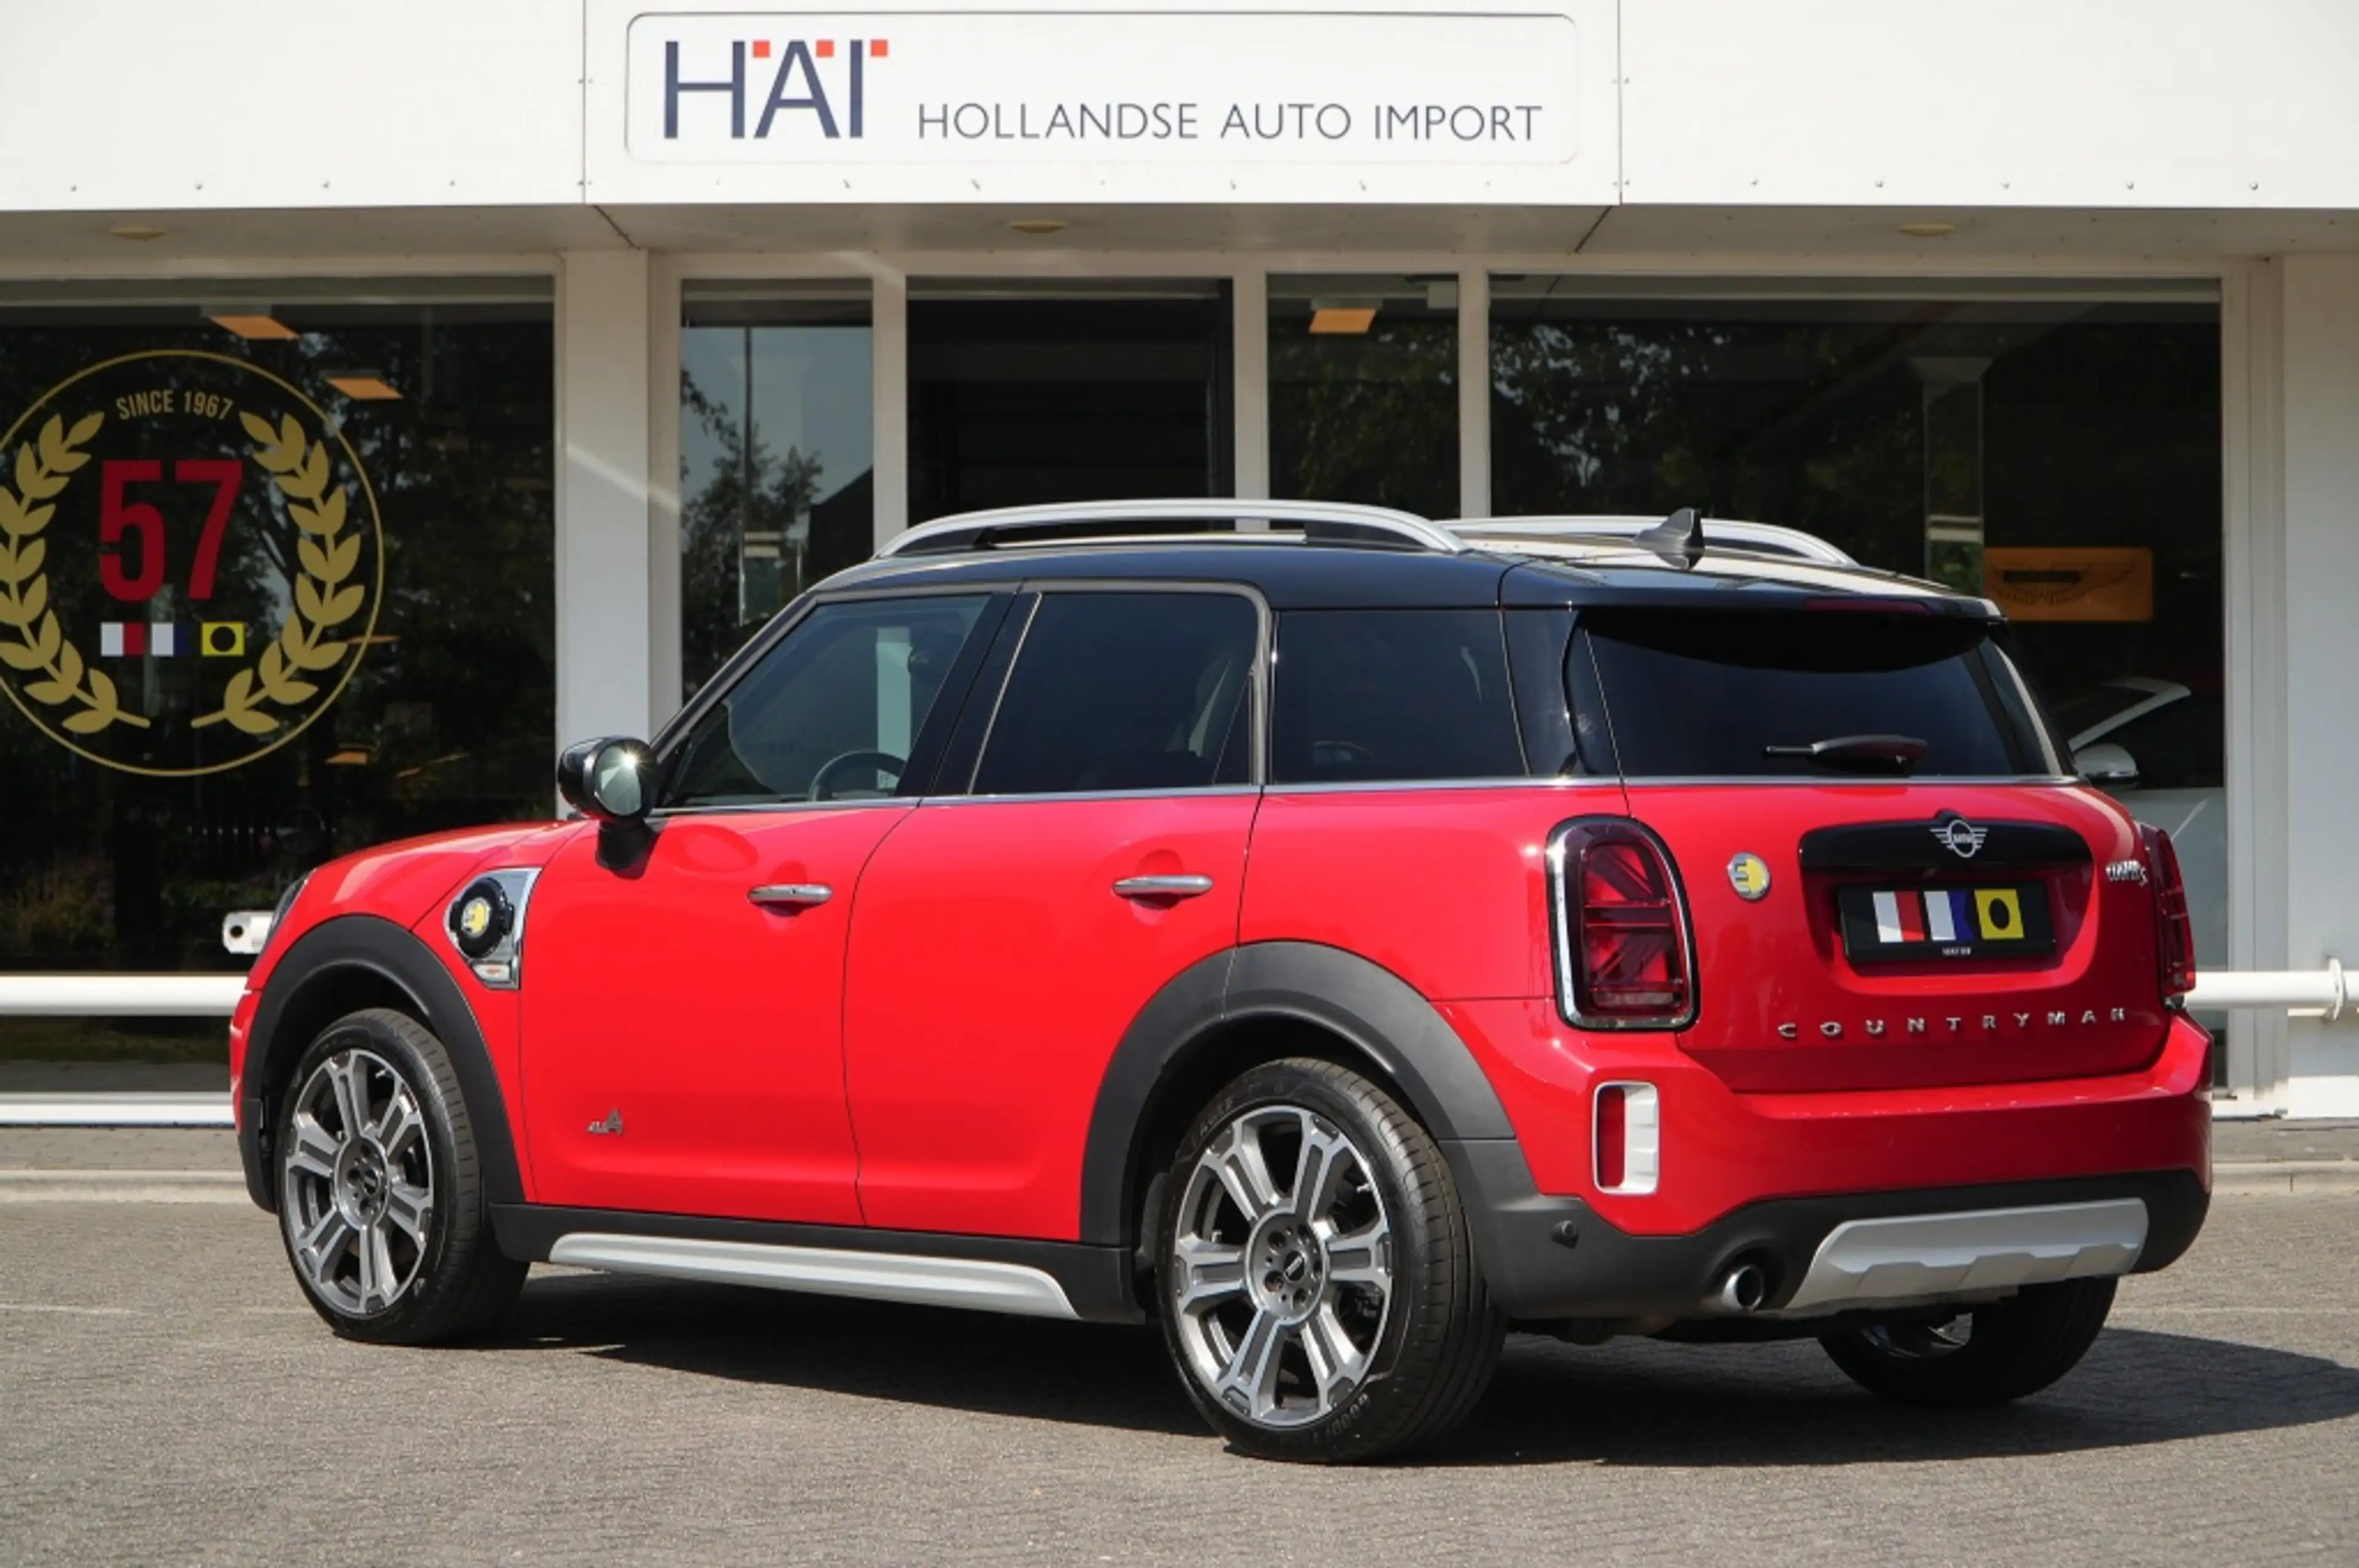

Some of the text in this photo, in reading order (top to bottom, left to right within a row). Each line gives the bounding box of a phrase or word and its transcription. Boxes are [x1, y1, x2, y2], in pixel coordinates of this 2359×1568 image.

[919, 103, 1543, 141] HOLLANDSE AUTO IMPORT
[116, 389, 234, 419] SINCE 1967
[100, 459, 243, 602] 57
[1778, 1007, 2126, 1038] COUNTRYMAN
